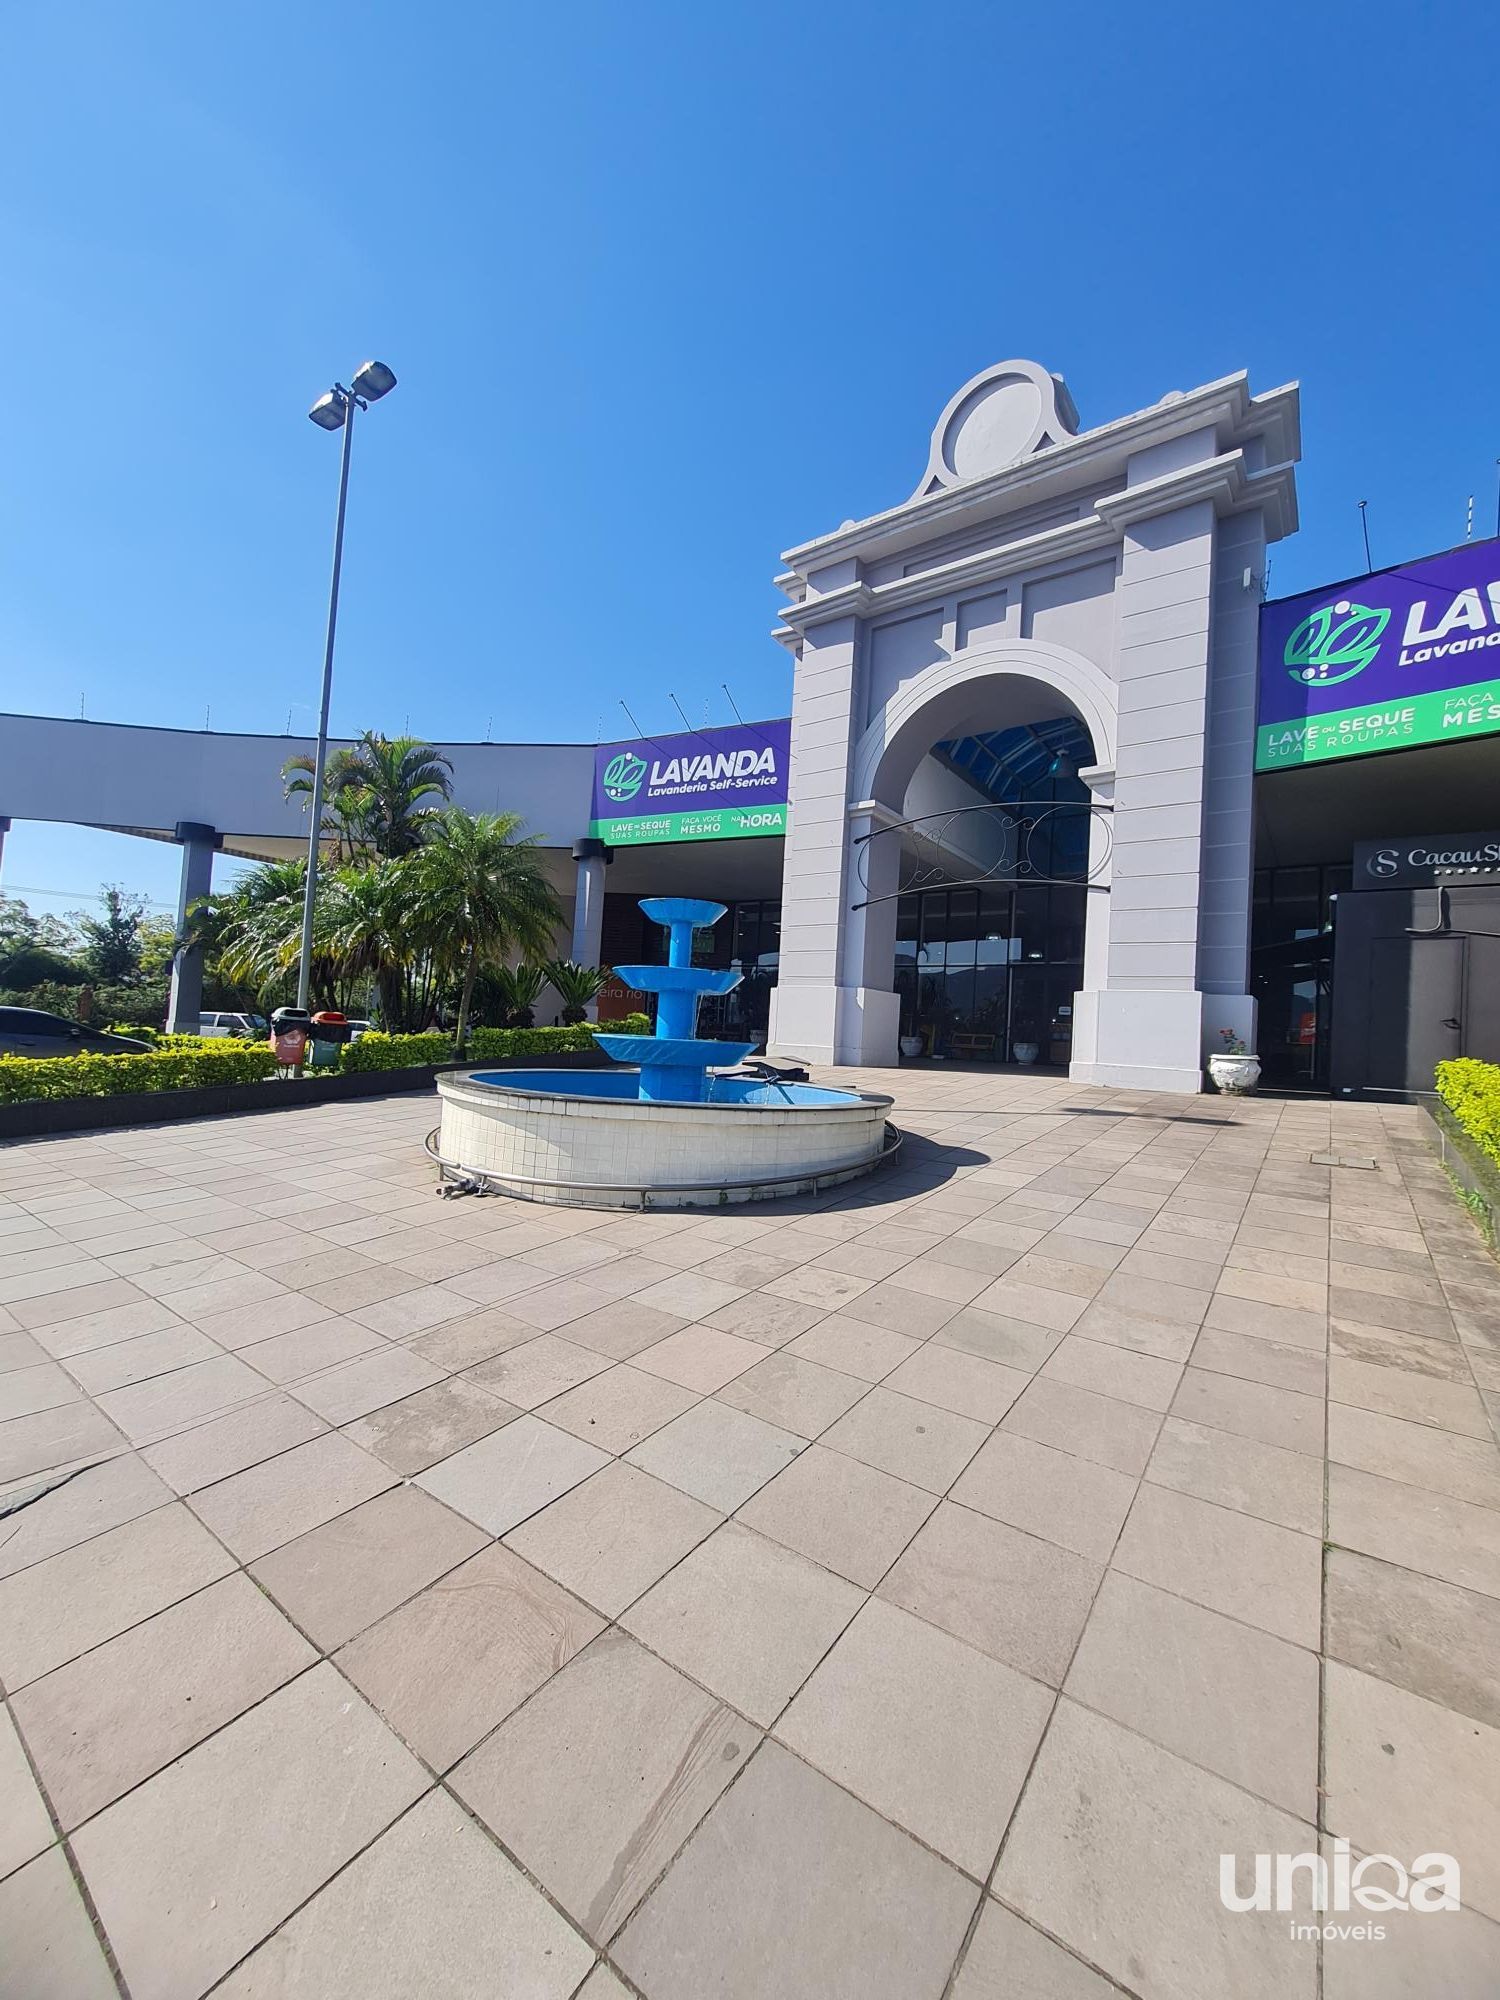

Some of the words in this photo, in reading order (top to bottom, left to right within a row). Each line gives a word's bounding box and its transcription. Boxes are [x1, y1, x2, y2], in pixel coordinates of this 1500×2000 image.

[1444, 692, 1494, 711] FAÇA
[1268, 726, 1319, 747] LAVE
[1338, 708, 1415, 734] SEQUE
[1267, 740, 1317, 758] SUAS
[1326, 723, 1414, 747] ROUPAS
[650, 747, 776, 786] LAVANDA
[647, 782, 707, 797] Lavanderia
[709, 775, 777, 790] Self-Service
[611, 823, 634, 833] LAVE
[640, 819, 672, 831] SEQUE
[680, 823, 721, 834] MESMO
[740, 812, 783, 829] HORA
[611, 831, 633, 840] SUAS
[635, 828, 671, 838] ROUPAS
[599, 989, 623, 998] eira
[626, 990, 643, 999] rio
